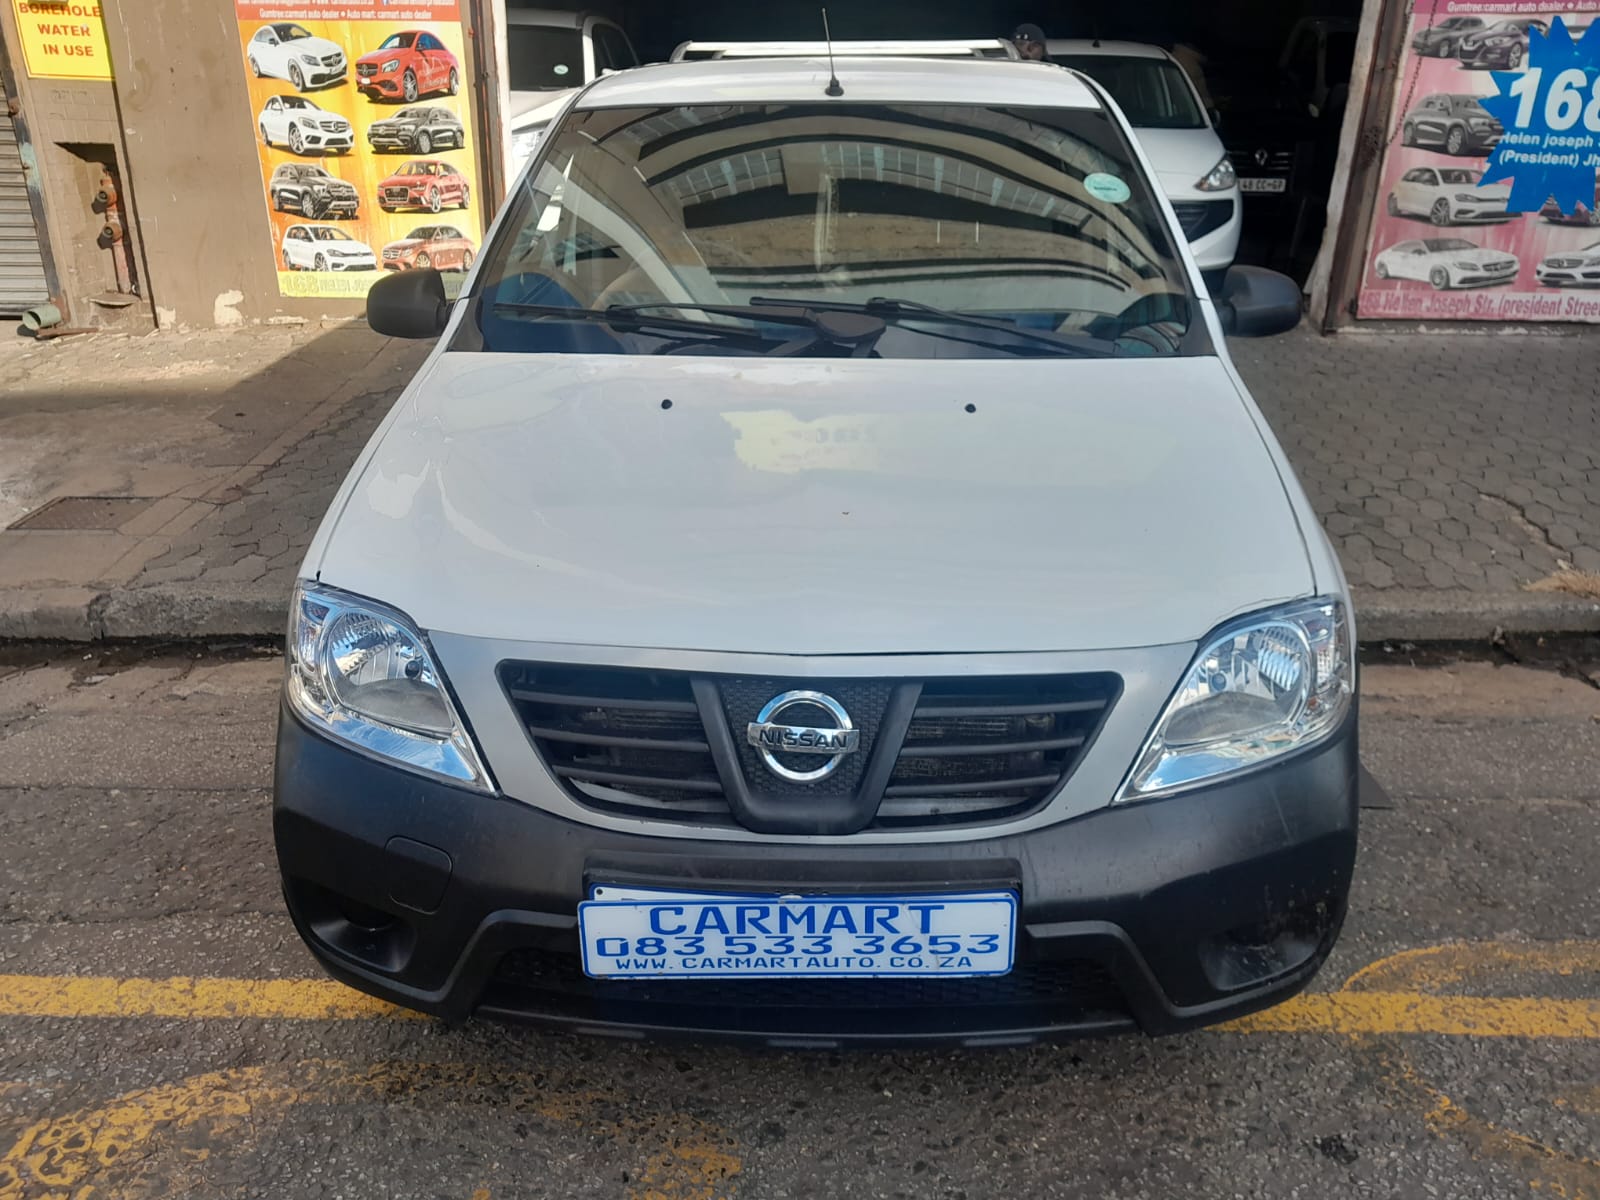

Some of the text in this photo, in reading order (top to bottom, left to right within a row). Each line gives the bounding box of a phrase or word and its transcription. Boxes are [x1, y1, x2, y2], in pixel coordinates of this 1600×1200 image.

[19, 3, 101, 17] BOREHOLE
[38, 24, 91, 37] WATER
[43, 44, 94, 57] IN USE
[1542, 133, 1594, 149] joseph
[1499, 149, 1579, 168] (President)
[1565, 296, 1600, 316] Stree
[758, 728, 848, 749] NISSAN
[649, 905, 945, 935] CARMART
[596, 934, 1000, 957] 083 533 3653
